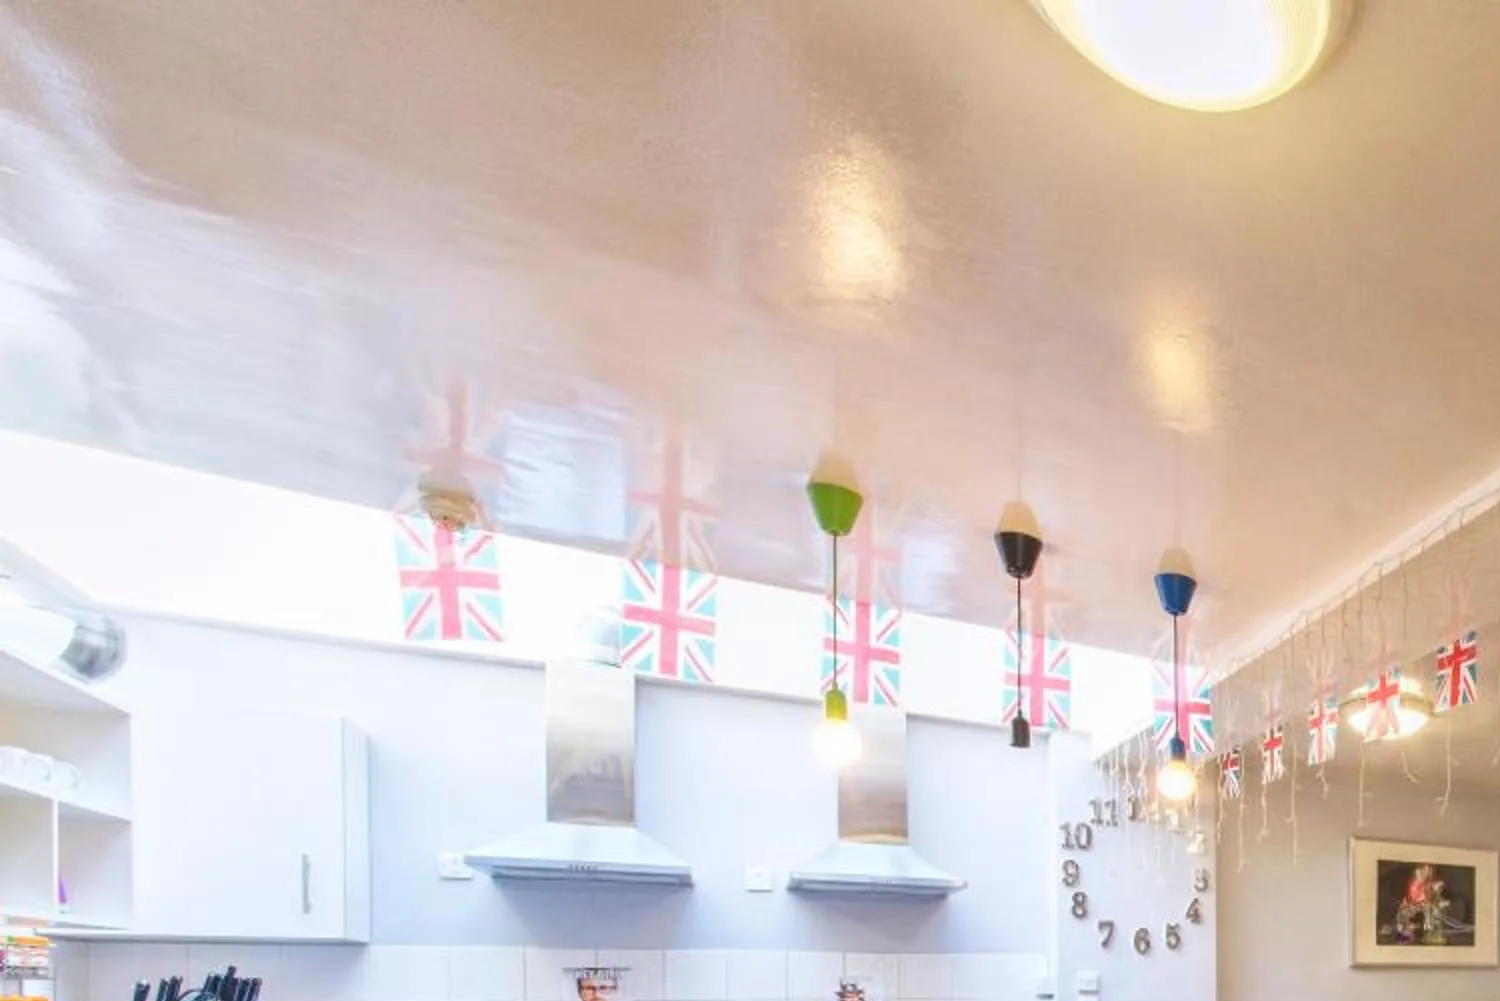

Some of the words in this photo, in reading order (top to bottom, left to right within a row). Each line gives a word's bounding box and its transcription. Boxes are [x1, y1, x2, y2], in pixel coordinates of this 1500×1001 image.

[1089, 798, 1119, 827] 11
[1059, 822, 1093, 850] 10
[1062, 860, 1080, 887] 9
[1072, 892, 1088, 919] 8
[1186, 898, 1202, 924] 4
[1098, 921, 1115, 948] 7
[1133, 928, 1151, 955] 6
[1165, 923, 1181, 950] 5
